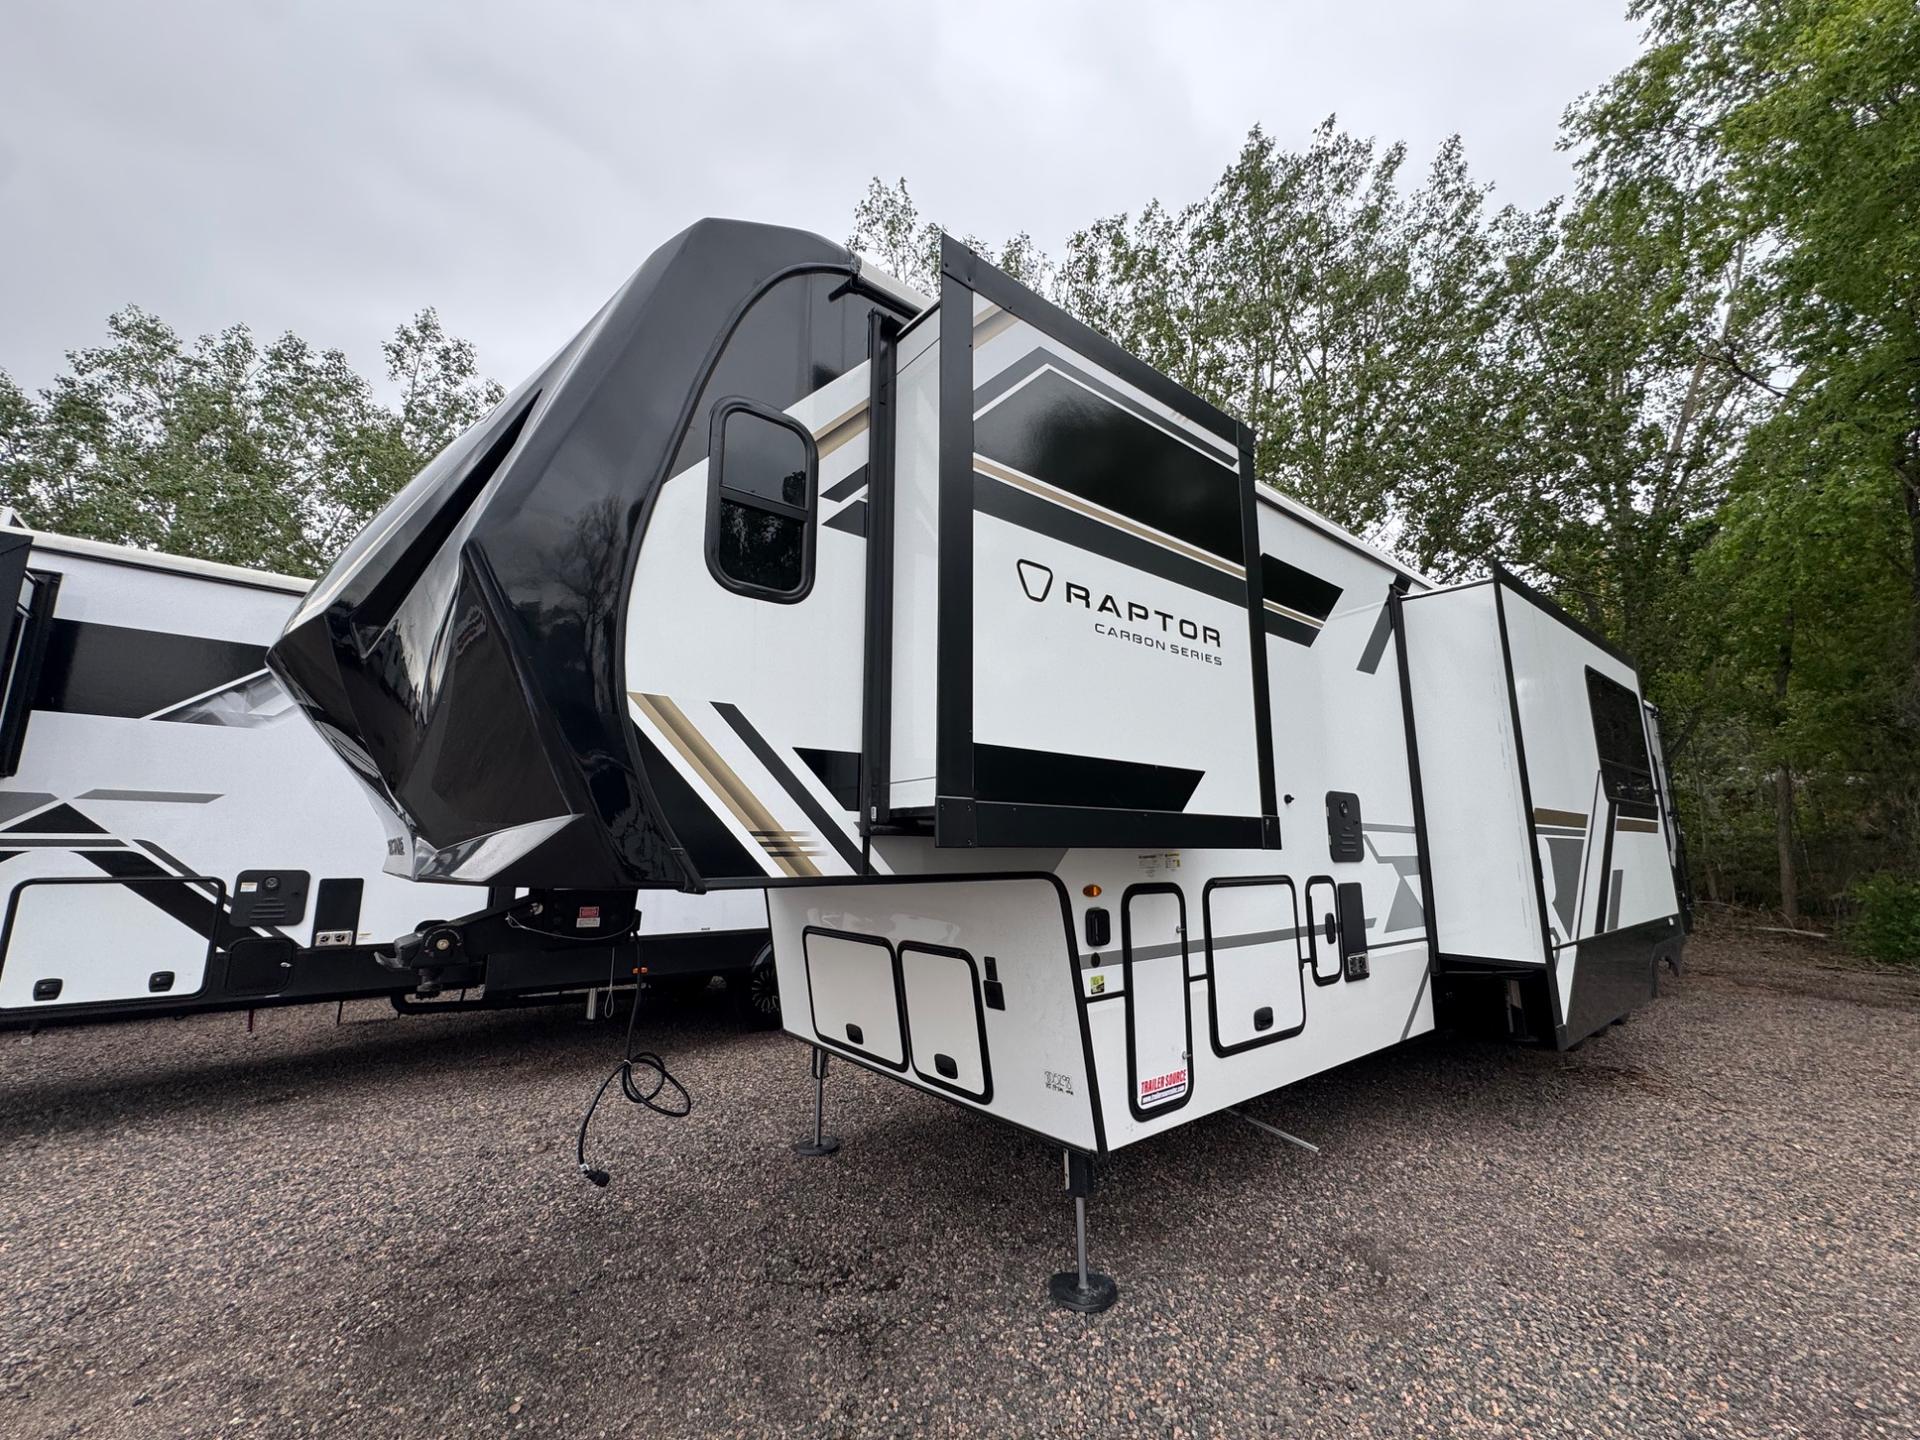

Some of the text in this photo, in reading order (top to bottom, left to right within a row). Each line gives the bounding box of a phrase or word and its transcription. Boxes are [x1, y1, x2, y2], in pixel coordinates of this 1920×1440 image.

[1065, 581, 1221, 648] RAPTOR
[1094, 622, 1222, 666] CARBON SERIES
[1141, 1076, 1164, 1094] TRAILER
[1165, 1069, 1187, 1087] SOURCE
